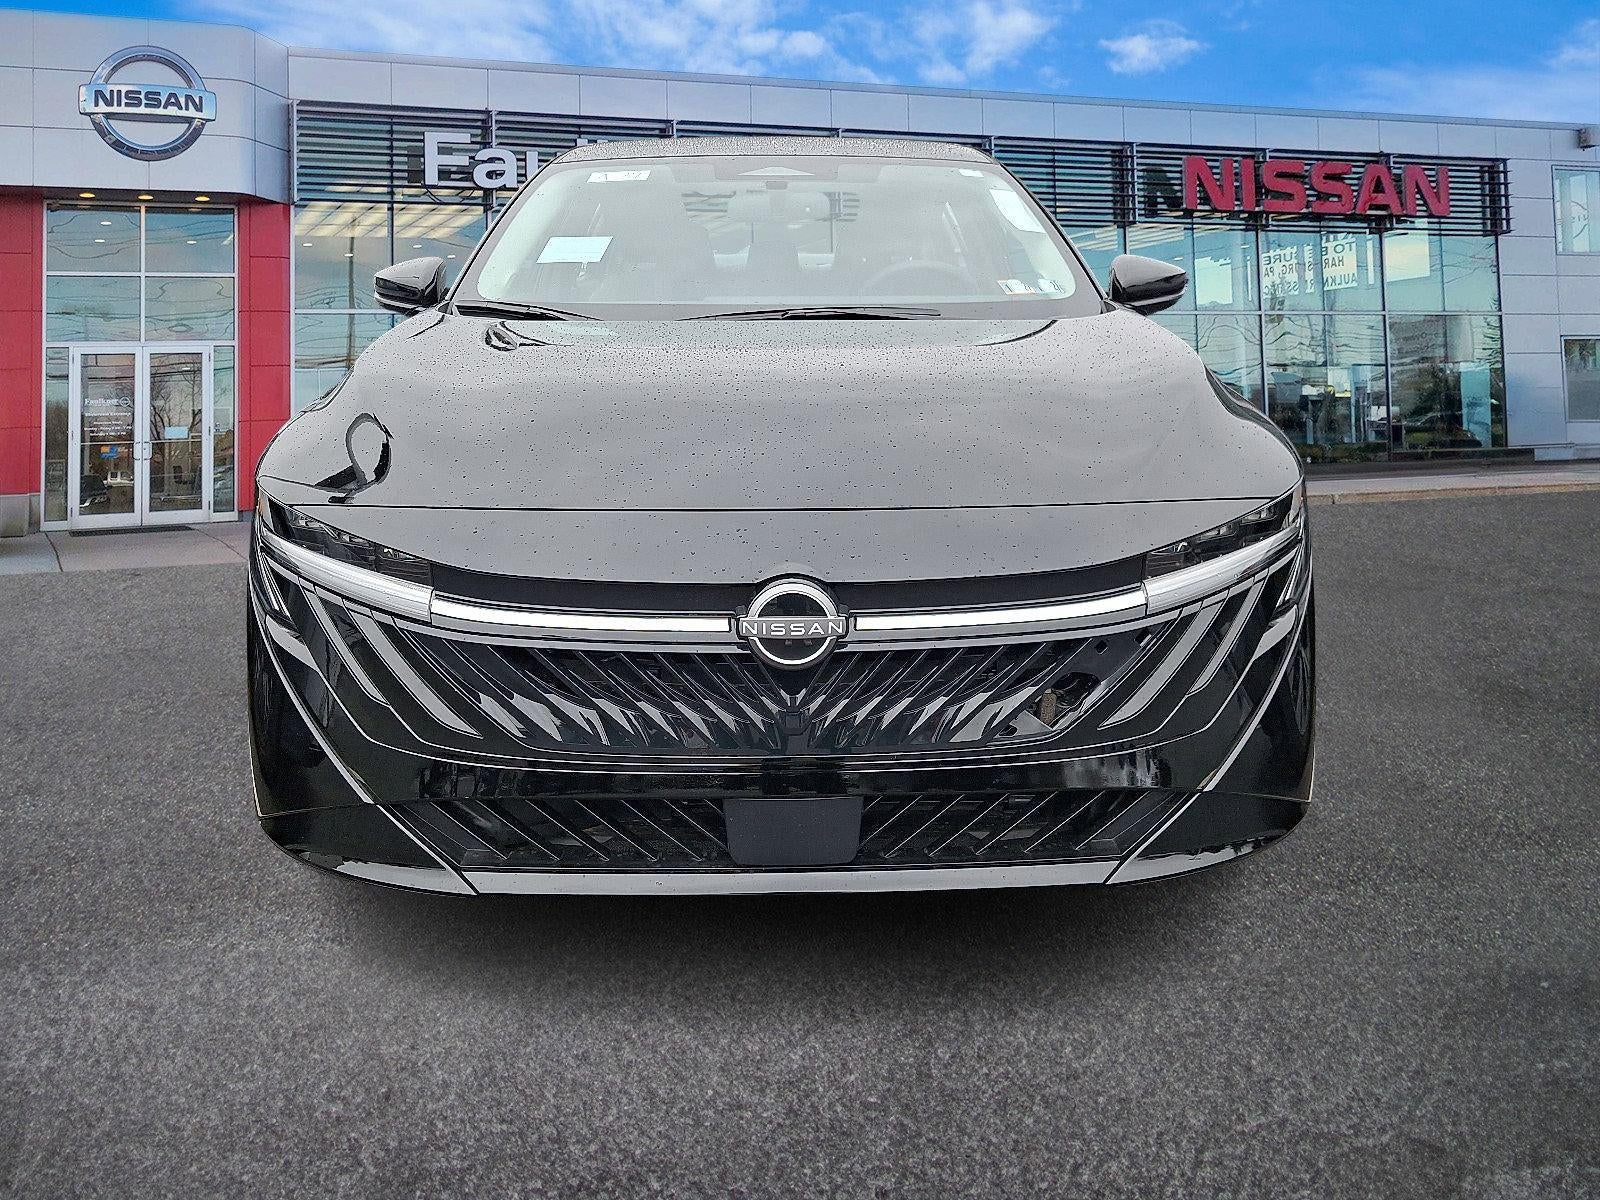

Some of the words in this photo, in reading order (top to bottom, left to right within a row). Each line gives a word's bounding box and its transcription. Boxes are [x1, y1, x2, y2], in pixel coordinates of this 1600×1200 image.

[94, 89, 203, 113] NISSAN
[1183, 155, 1450, 216] NISSAN
[742, 622, 843, 636] NISSAN
